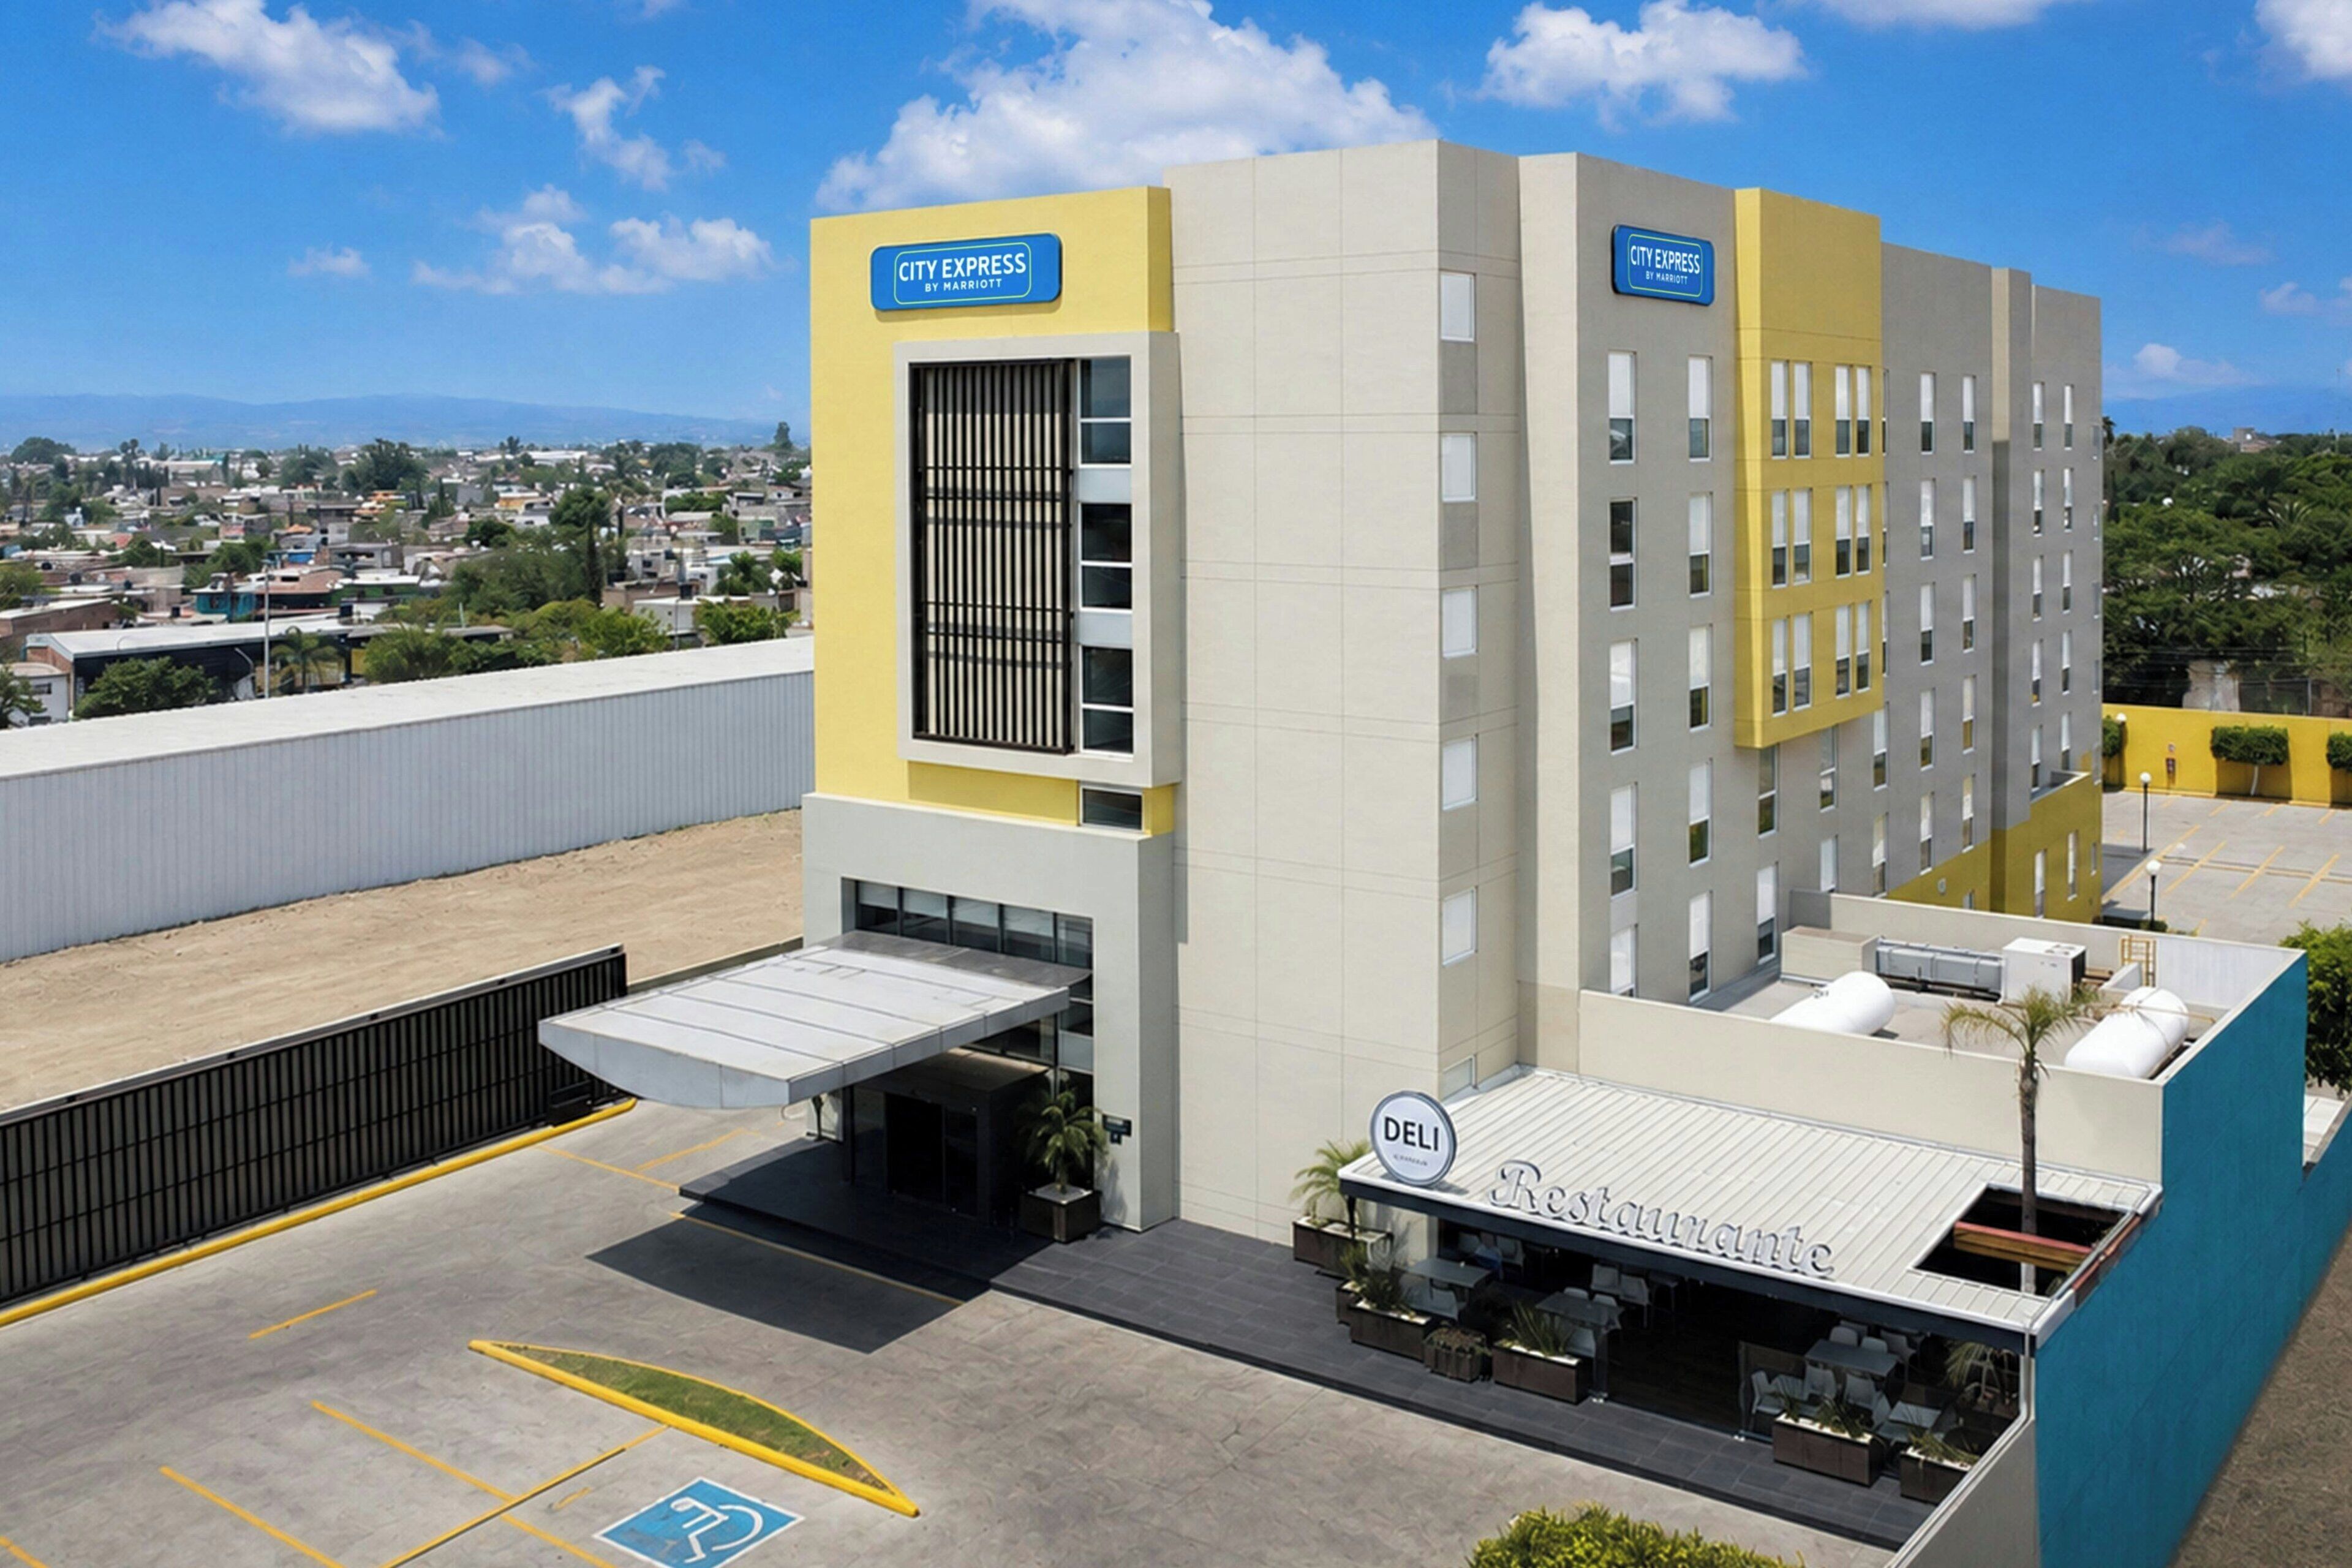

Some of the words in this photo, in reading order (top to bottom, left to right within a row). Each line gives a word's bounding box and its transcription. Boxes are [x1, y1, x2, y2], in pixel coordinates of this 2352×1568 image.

[899, 260, 938, 282] CITY
[941, 252, 1027, 279] EXPRESS
[1630, 245, 1653, 268] CITY
[1655, 249, 1700, 274] EXPRESS
[924, 283, 938, 292] BY
[943, 279, 1002, 291] MARRIOTT
[1645, 271, 1654, 280] BY
[1656, 273, 1688, 285] MARRIOTT
[1384, 1116, 1439, 1152] DELI
[1487, 1159, 1834, 1279] Restaurante
